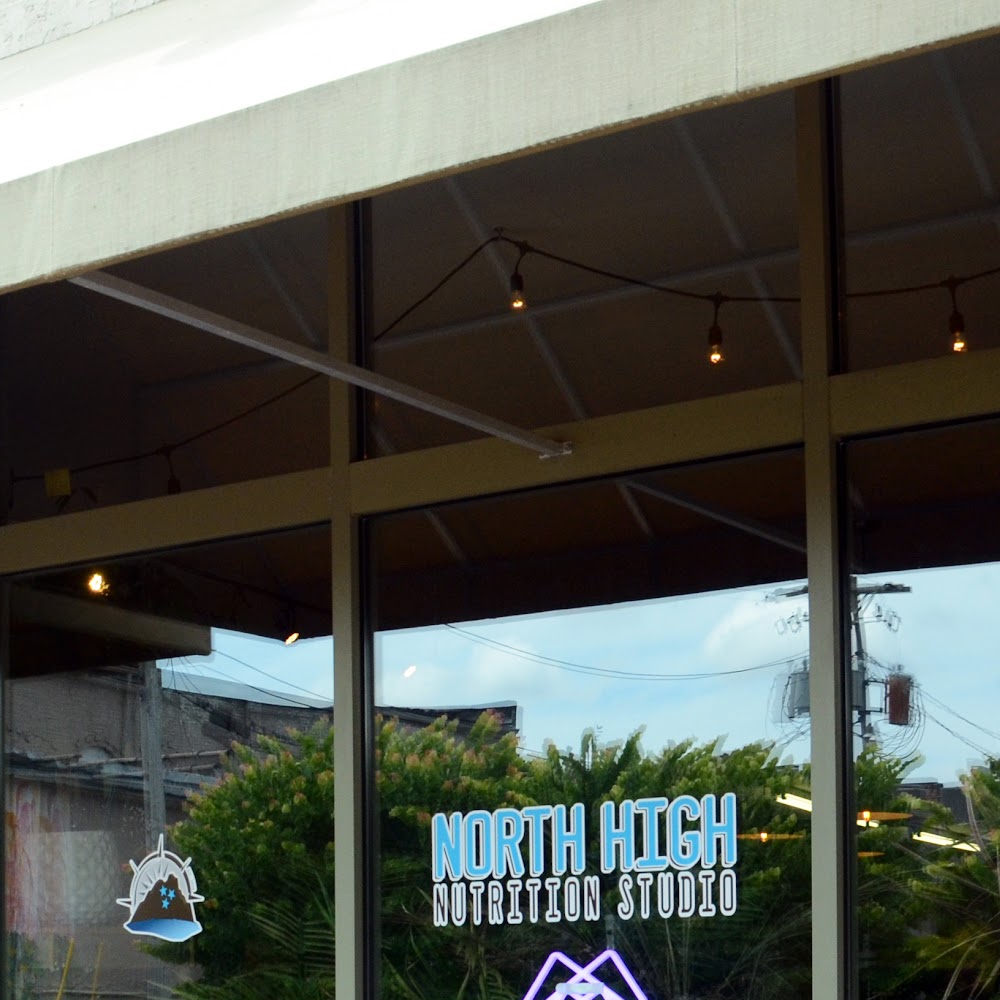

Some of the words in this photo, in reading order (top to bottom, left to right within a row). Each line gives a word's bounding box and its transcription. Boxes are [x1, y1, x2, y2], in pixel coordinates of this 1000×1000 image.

[432, 803, 586, 882] NORTH
[600, 793, 737, 873] HIGH
[433, 875, 600, 926] NUTRITION
[617, 869, 737, 920] STUDIO
